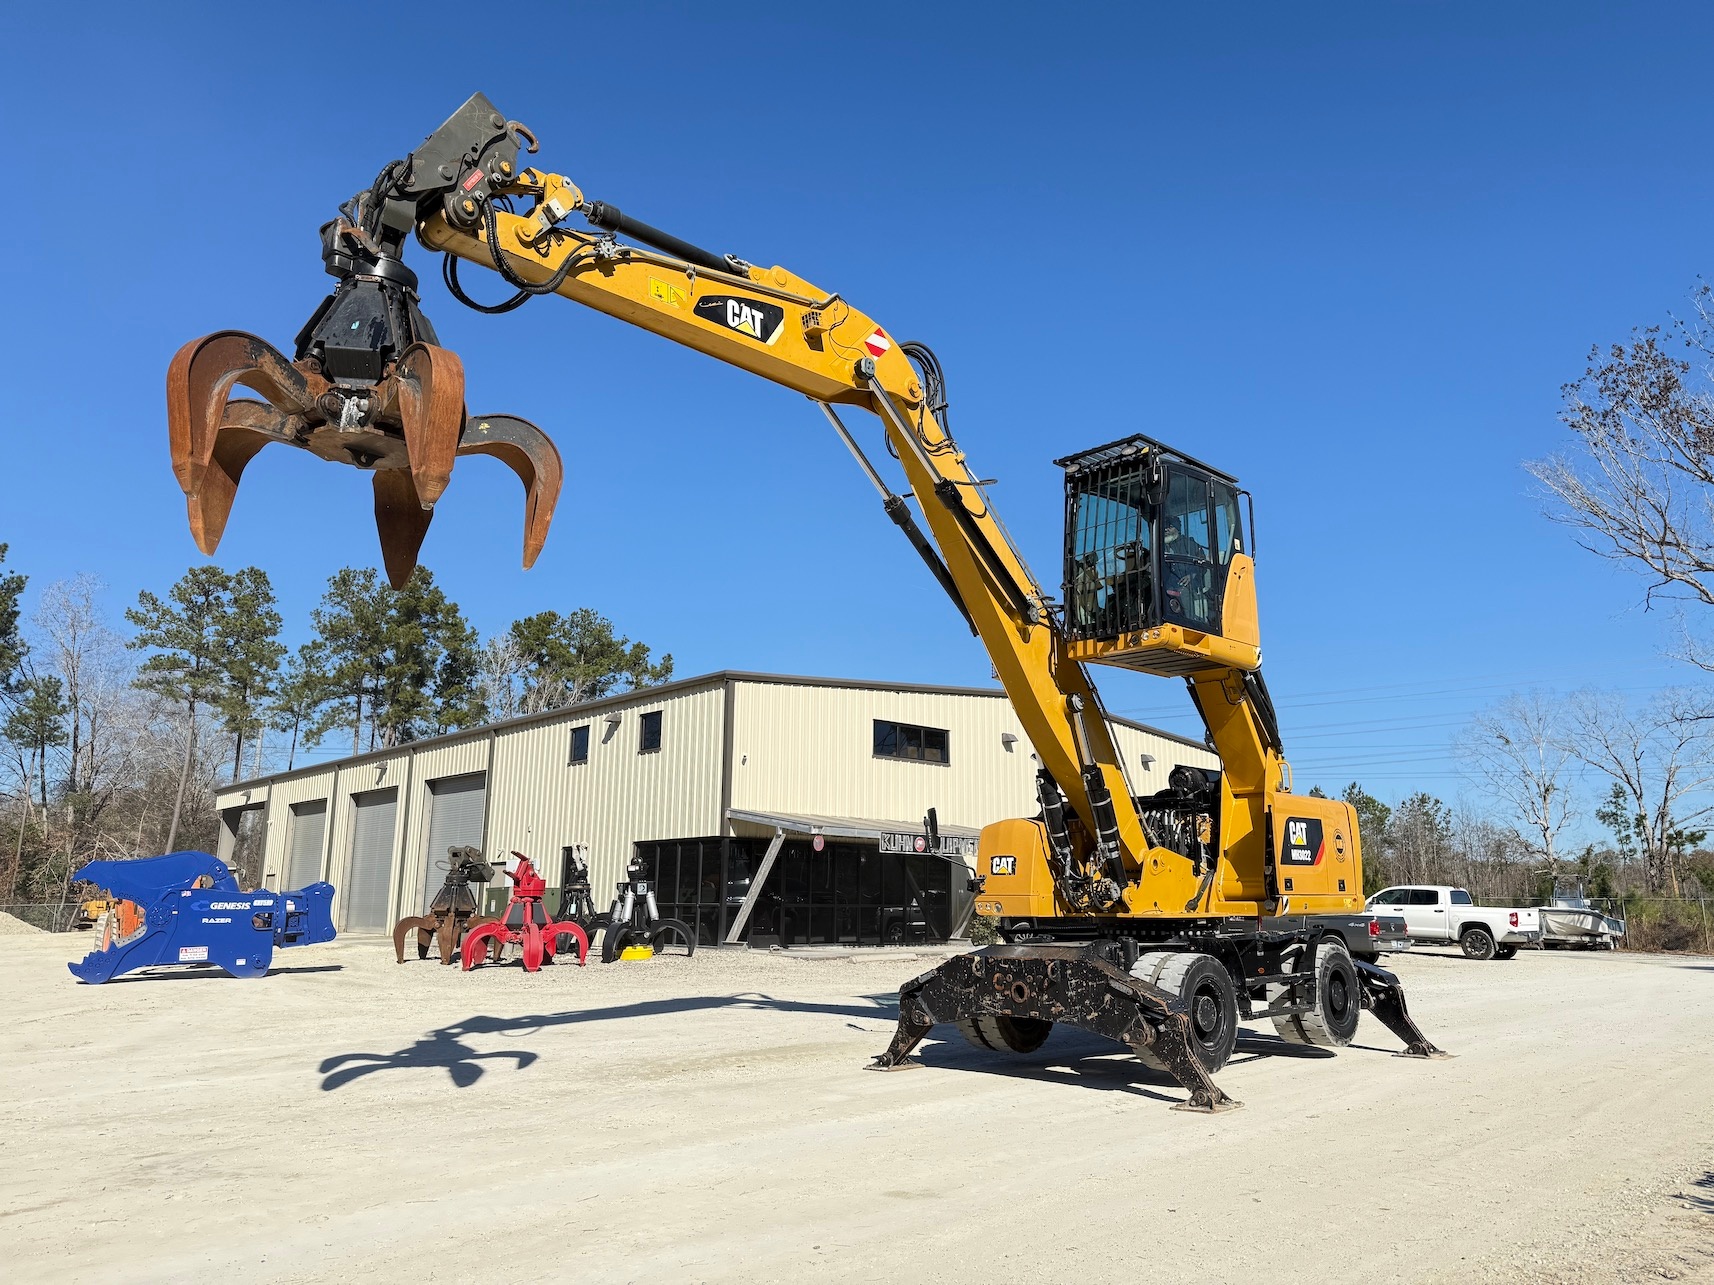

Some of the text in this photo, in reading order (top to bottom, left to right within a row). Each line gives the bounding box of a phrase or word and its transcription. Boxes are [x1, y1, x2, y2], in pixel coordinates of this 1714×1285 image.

[727, 299, 764, 338] CAT
[881, 833, 914, 852] KUHN
[1289, 821, 1307, 846] CAT
[992, 856, 1015, 875] CAT
[210, 902, 251, 910] GENESIS
